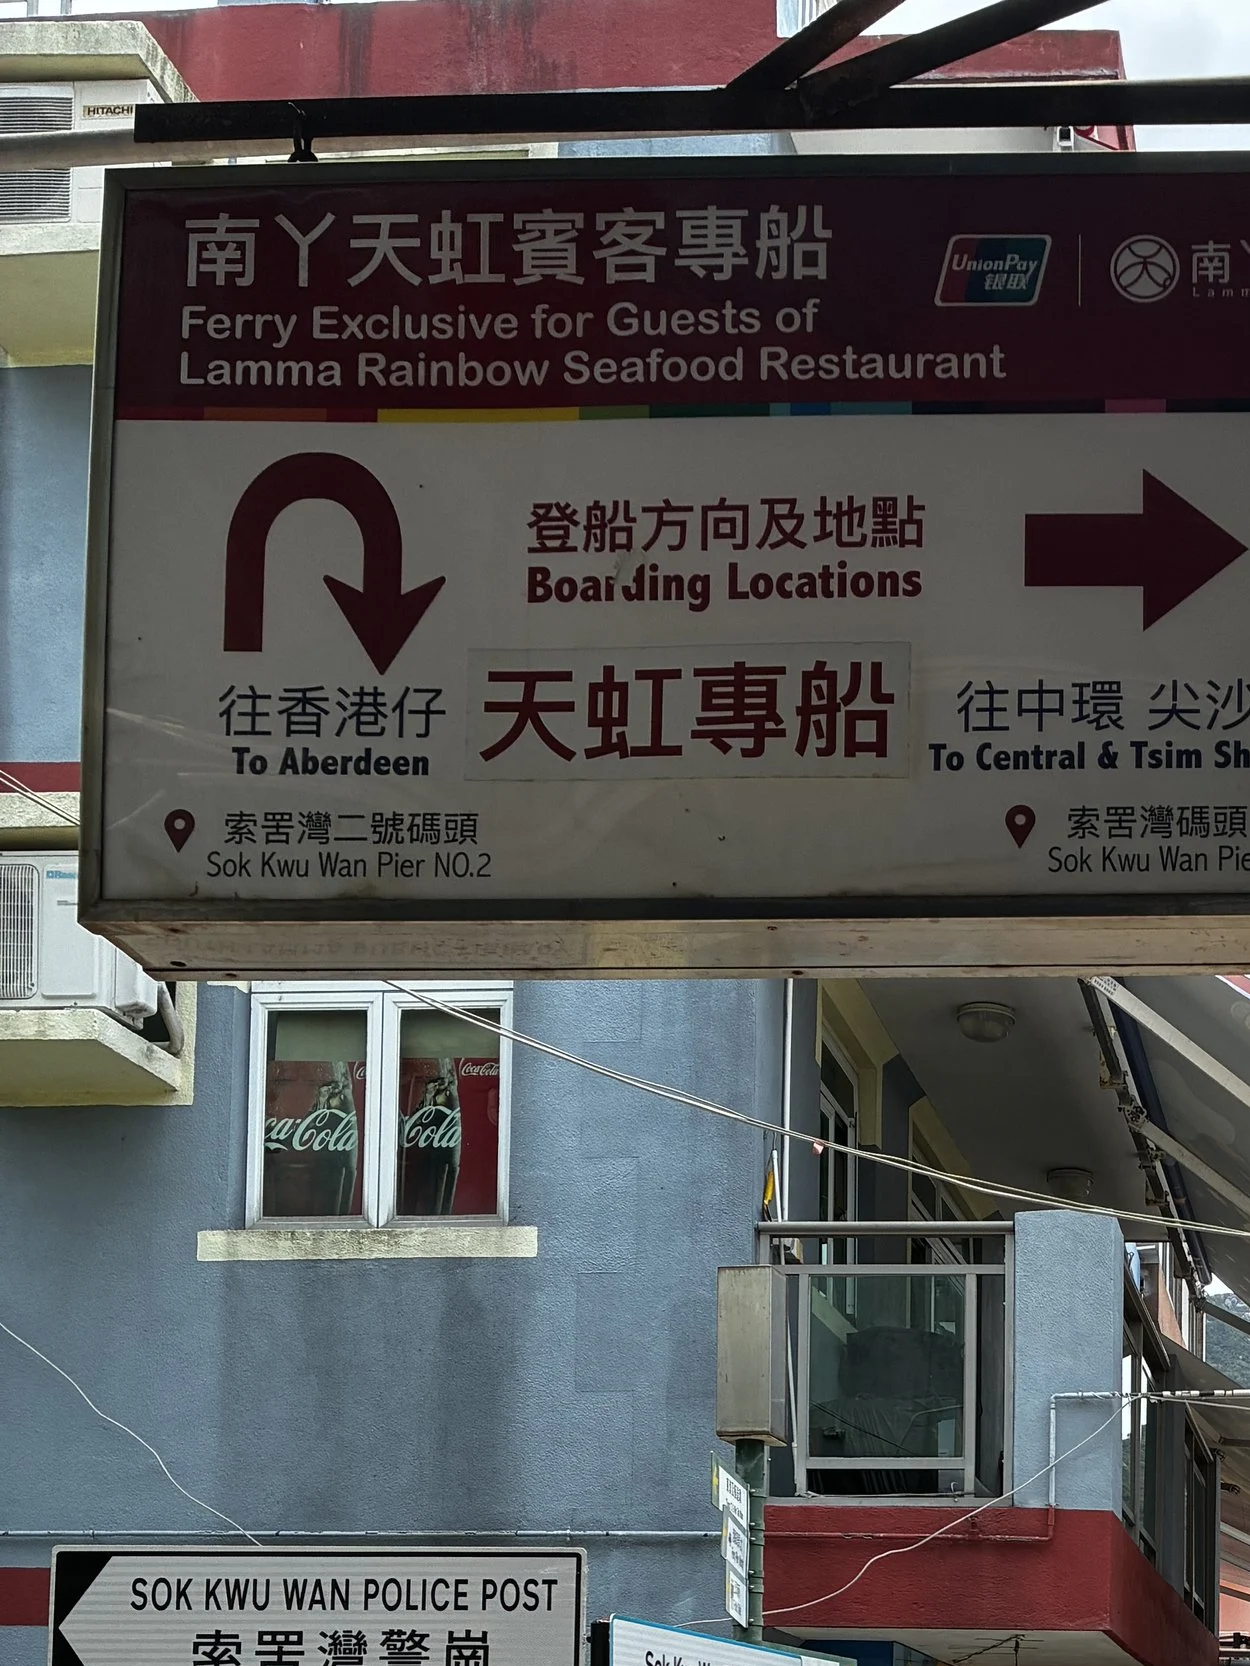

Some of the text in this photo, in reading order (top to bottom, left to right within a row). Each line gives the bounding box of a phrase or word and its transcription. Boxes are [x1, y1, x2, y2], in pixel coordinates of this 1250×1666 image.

[87, 106, 133, 116] HITACHI
[185, 204, 833, 288] 南丫天虹賓客專船
[951, 253, 1038, 277] UnionPay
[984, 273, 1030, 291] 银联
[181, 298, 820, 348] Ferry Exclusive for Guests of
[180, 344, 1007, 387] Lamma Rainbow Seafood Restaurant
[527, 495, 926, 554] 登船方向及地點
[527, 560, 923, 612] Boarding Locations
[217, 683, 447, 741] 往香港仔
[479, 659, 895, 763] 天虹專船
[956, 679, 1126, 733] 往中環
[232, 748, 430, 777] To Aberdeen
[928, 742, 965, 771] To
[975, 740, 1086, 770] Central
[1097, 740, 1119, 769] &
[1129, 740, 1202, 769] Tsim
[223, 810, 480, 846] 索罟灣二號碼頭
[1066, 803, 1249, 840] 索罟灣碼頭
[206, 851, 492, 878] Sok Kwu Wan Pier NO.2
[1047, 845, 1093, 873] Sok
[1102, 845, 1150, 872] Kwu
[1159, 845, 1208, 872] Wan
[130, 1577, 558, 1613] SOK KWU WAN POLICE POST
